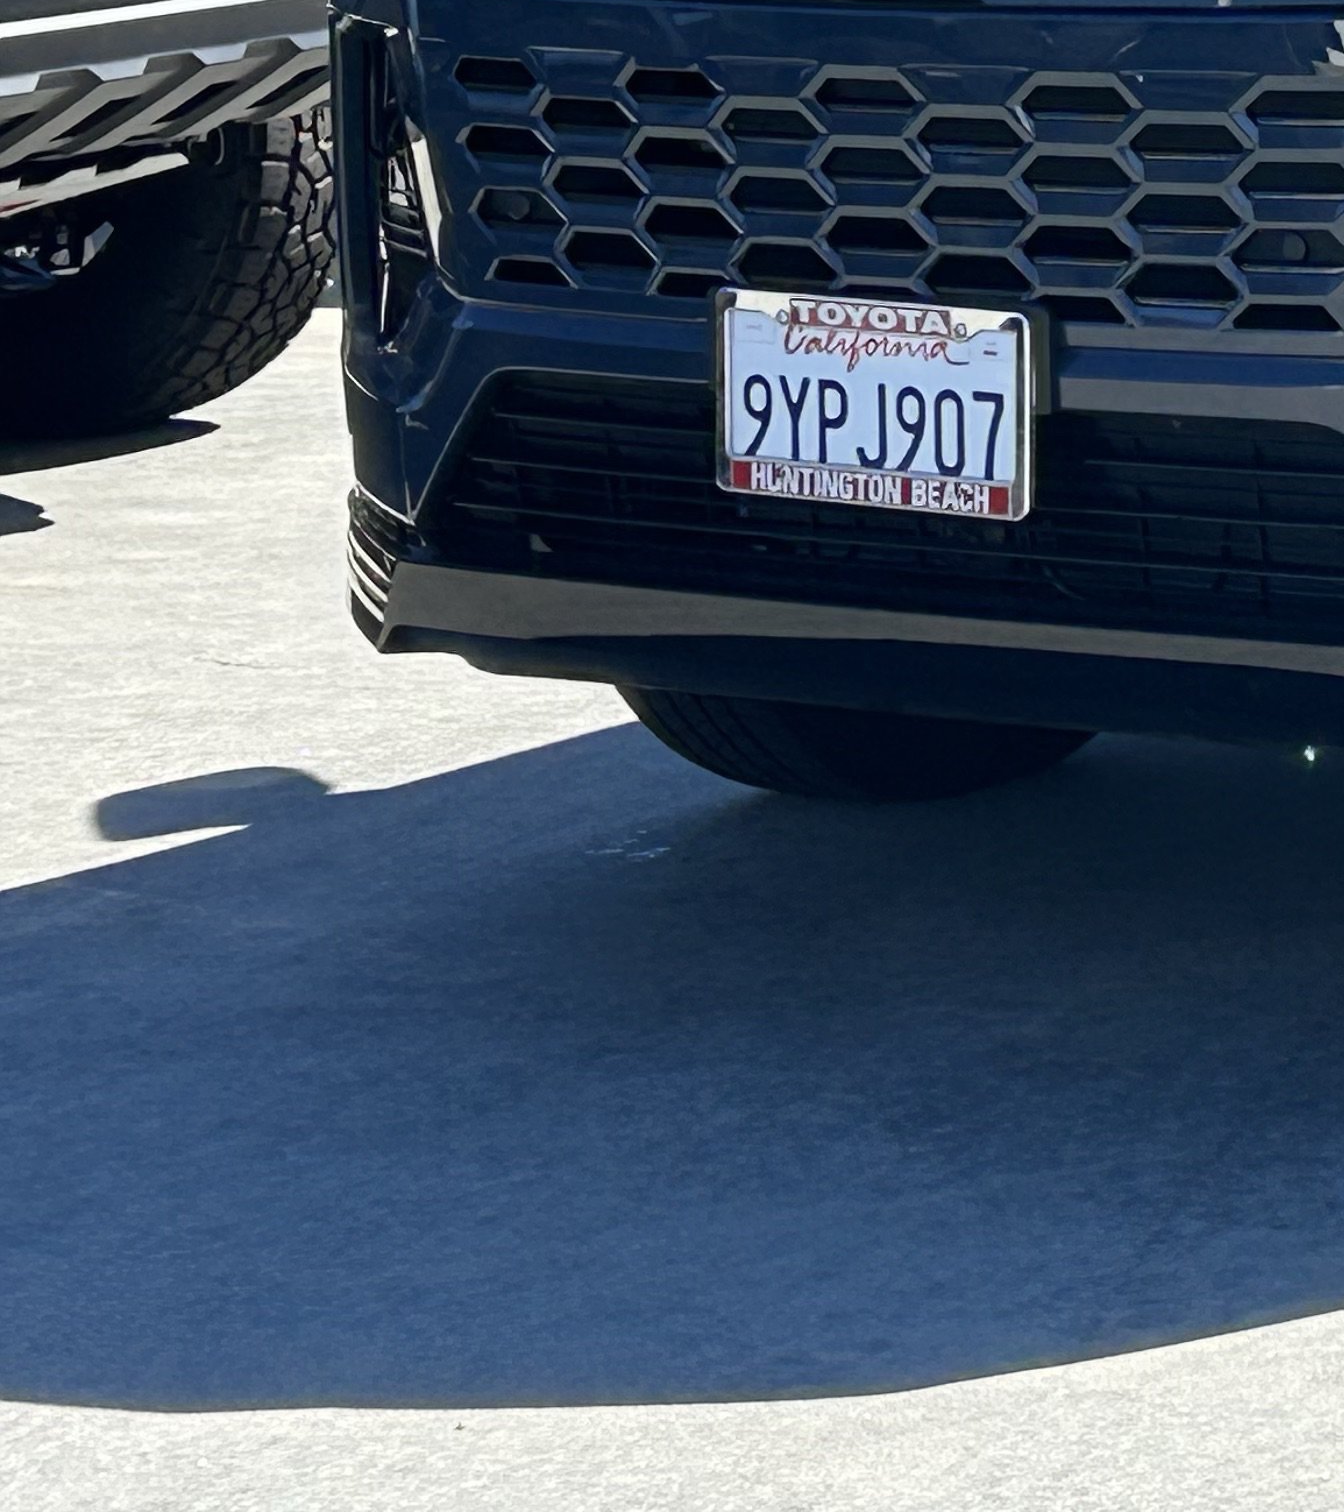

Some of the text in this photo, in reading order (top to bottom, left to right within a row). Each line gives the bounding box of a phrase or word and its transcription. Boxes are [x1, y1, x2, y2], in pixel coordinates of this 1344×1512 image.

[790, 299, 951, 336] TOYOTA
[783, 326, 970, 373] California
[743, 373, 1005, 482] 9YPJ907
[750, 462, 990, 515] HUNTINGTON BEACH
